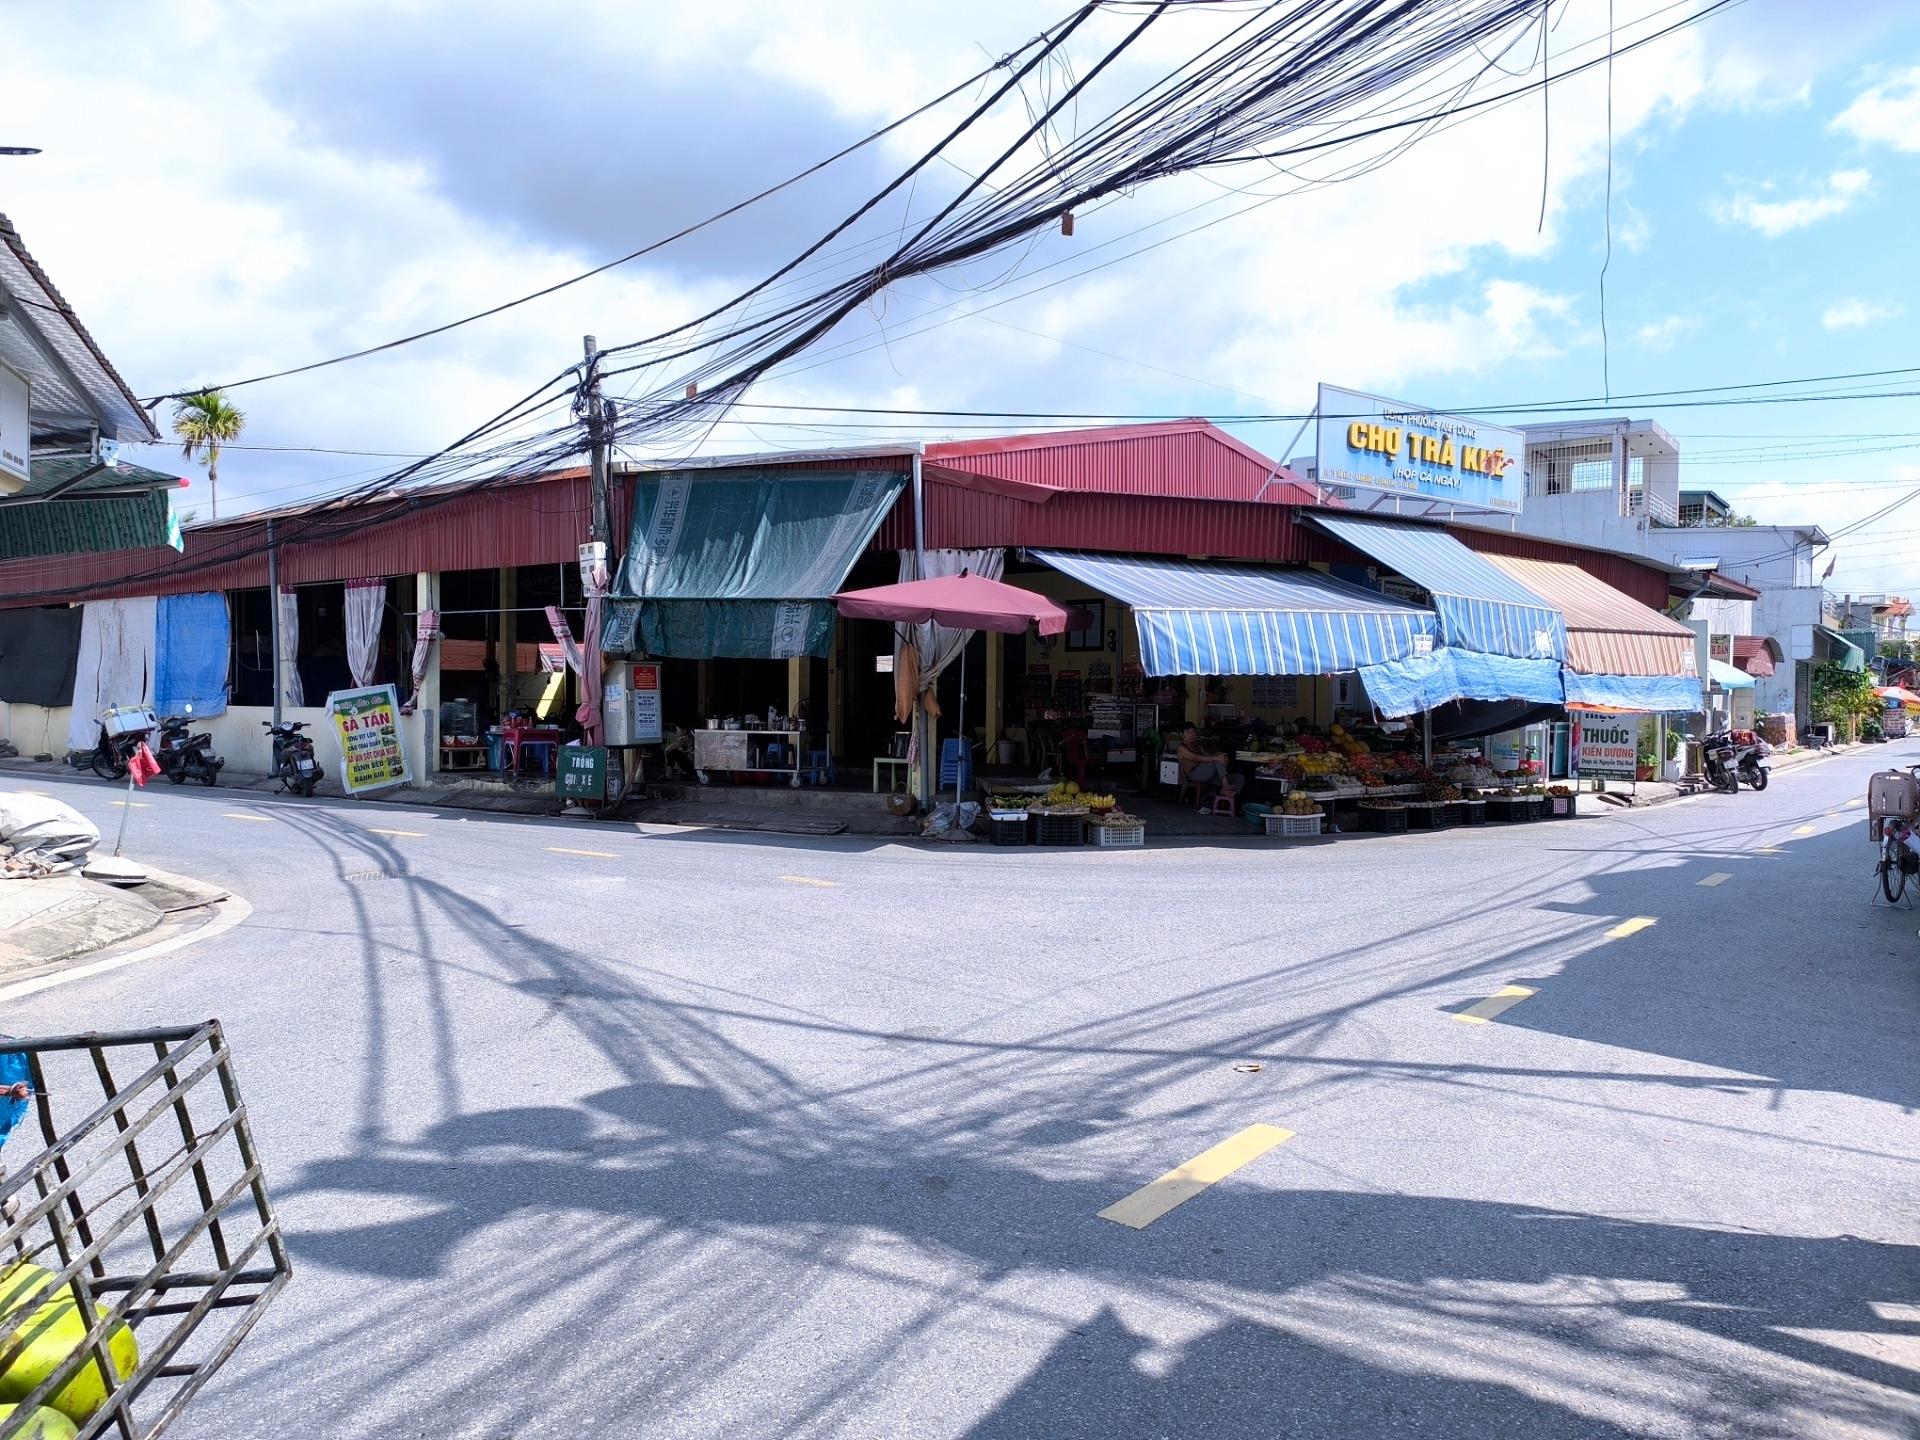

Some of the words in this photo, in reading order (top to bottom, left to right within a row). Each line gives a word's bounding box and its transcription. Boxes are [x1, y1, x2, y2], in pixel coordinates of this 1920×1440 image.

[1347, 422, 1401, 460] CHỢ
[1407, 432, 1456, 466] TRÀ
[1582, 724, 1629, 744] THUỐC
